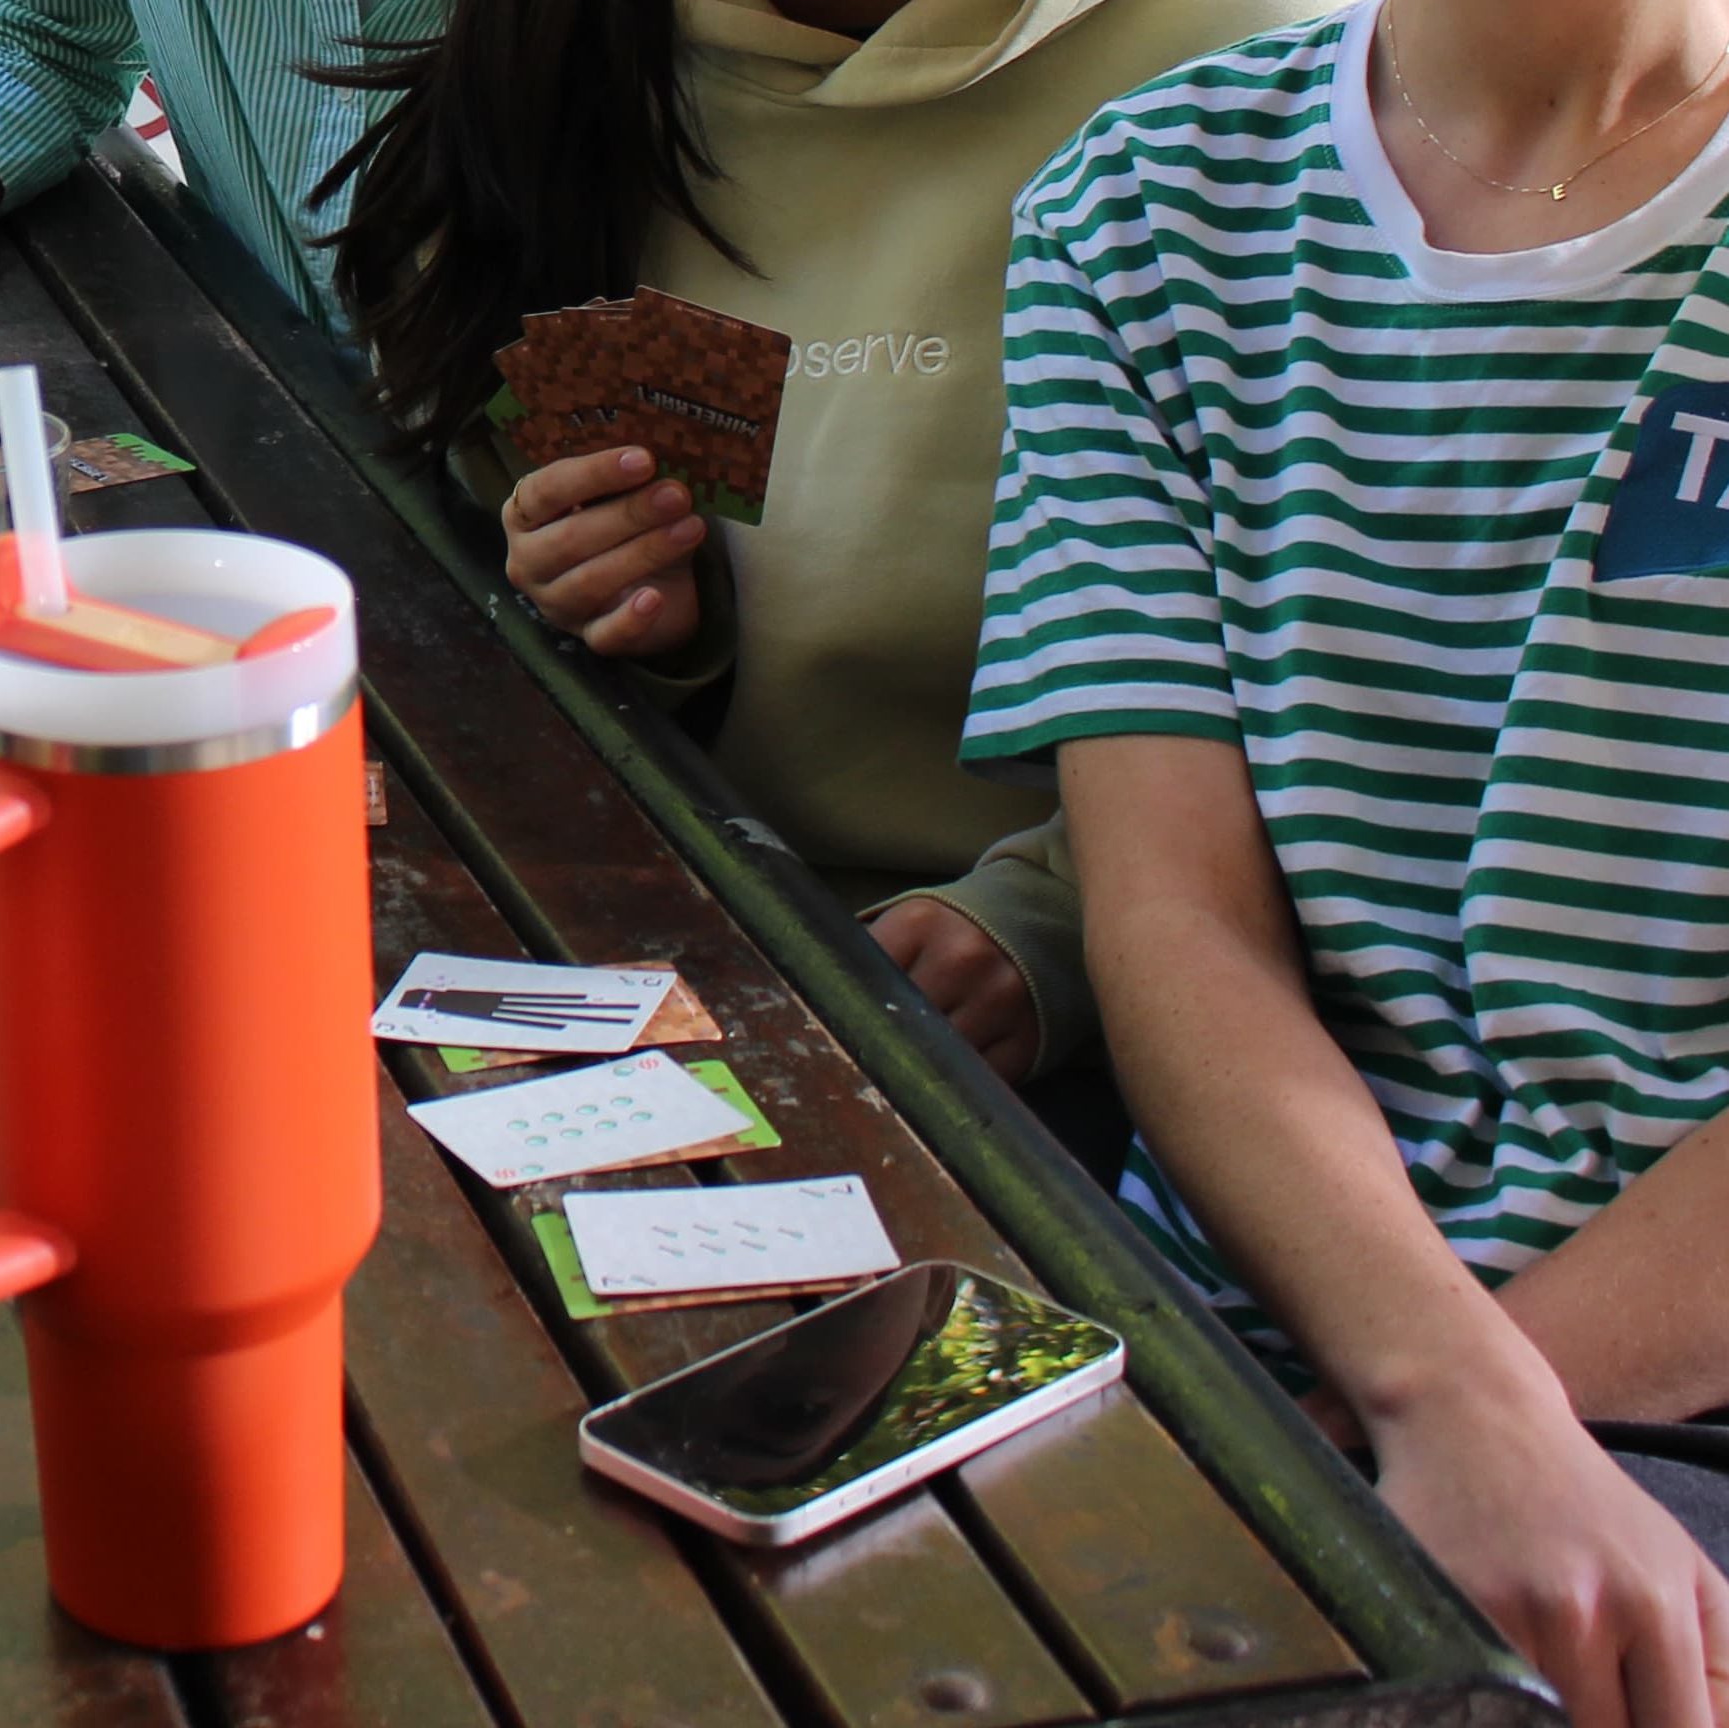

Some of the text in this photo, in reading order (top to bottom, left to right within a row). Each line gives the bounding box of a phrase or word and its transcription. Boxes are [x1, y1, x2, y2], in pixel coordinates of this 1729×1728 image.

[1552, 183, 1567, 200] E
[634, 385, 761, 440] MINECRAFT
[1671, 411, 1729, 510] T
